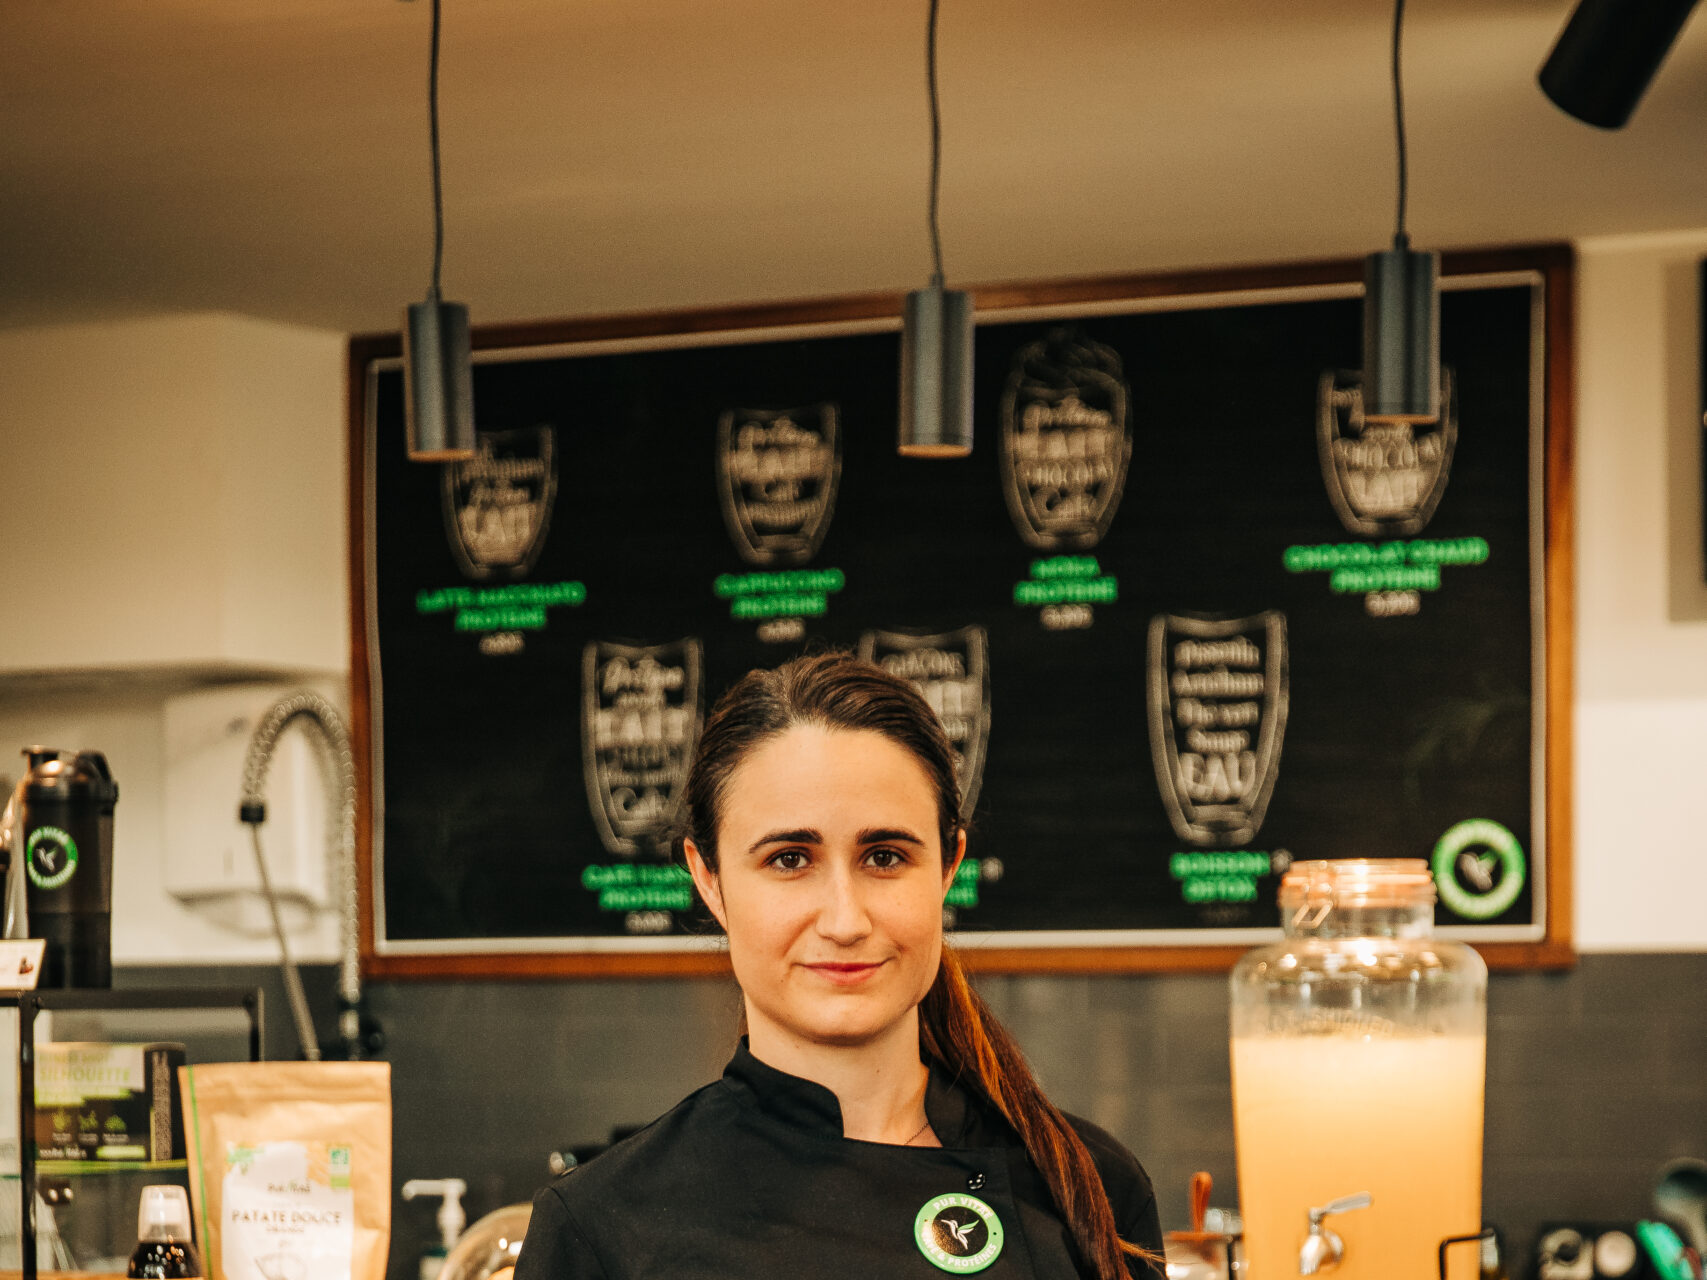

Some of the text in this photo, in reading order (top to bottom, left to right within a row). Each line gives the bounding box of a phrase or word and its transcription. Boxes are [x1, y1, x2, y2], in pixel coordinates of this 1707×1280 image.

[933, 1197, 957, 1211] PUR
[231, 1209, 342, 1225] PATATE DOUCE
